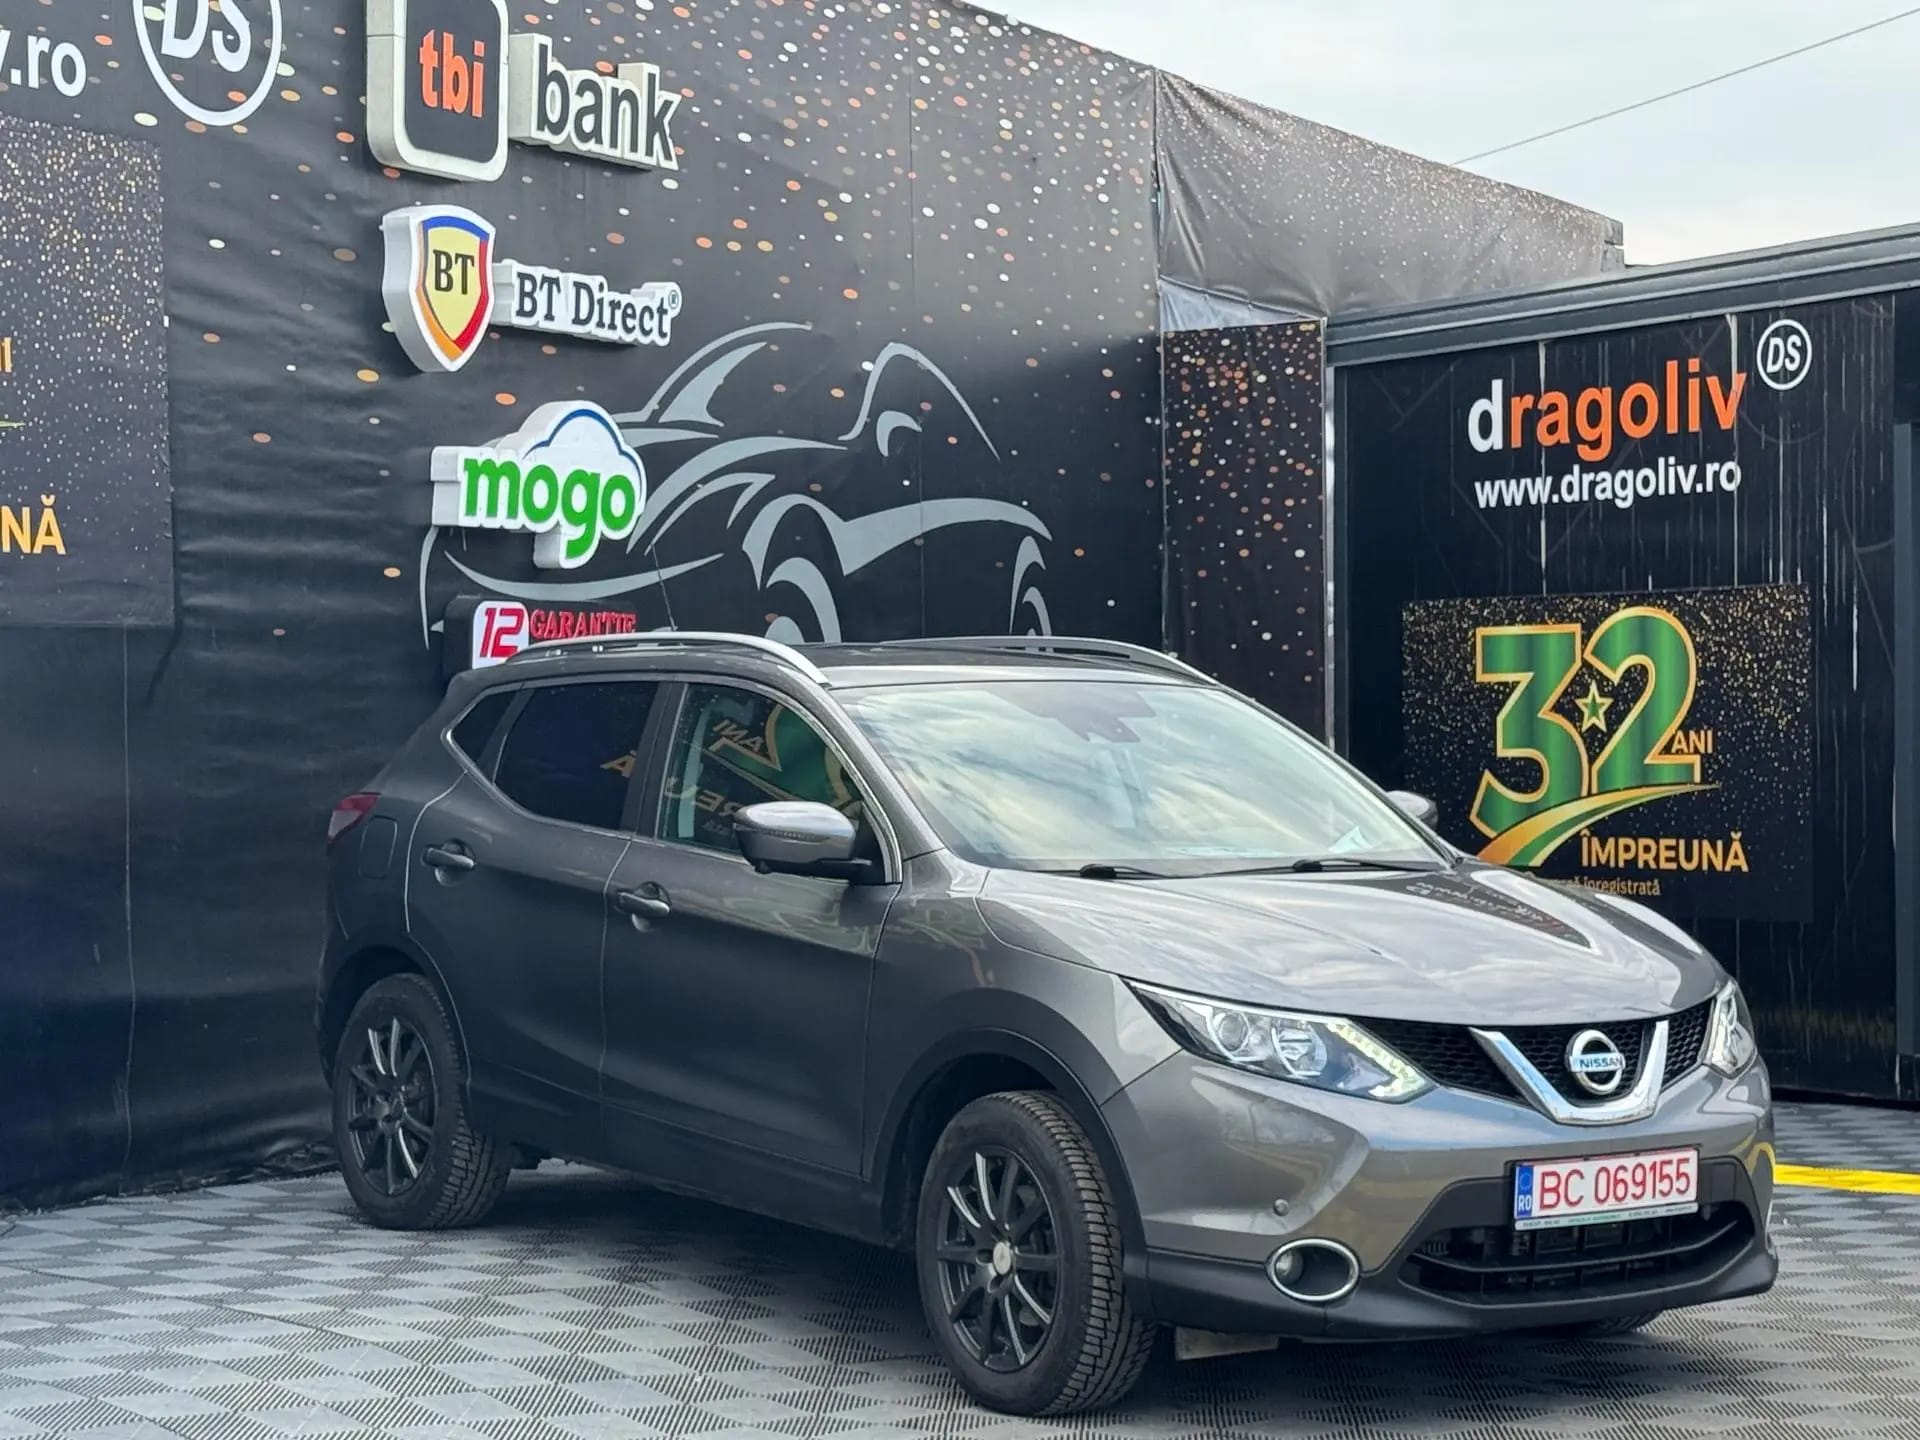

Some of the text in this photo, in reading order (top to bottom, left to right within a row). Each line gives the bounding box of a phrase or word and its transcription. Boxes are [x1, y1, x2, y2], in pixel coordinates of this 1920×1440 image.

[419, 29, 674, 162] tbi bank
[433, 250, 475, 295] BT
[516, 272, 561, 322] BT
[1766, 334, 1802, 374] DS
[1467, 358, 1747, 462] dragoliv
[1474, 456, 1742, 509] www.dragoliv.ro
[463, 458, 636, 560] mogo
[480, 607, 637, 658] 12 GARANTIE
[1469, 606, 1701, 839] 32
[1671, 729, 1714, 754] ANI
[1579, 828, 1749, 872] ÎMPREUNĂ
[1580, 1057, 1621, 1068] NISSAN
[1518, 1194, 1531, 1211] RO
[1539, 1158, 1691, 1211] BC 069155
